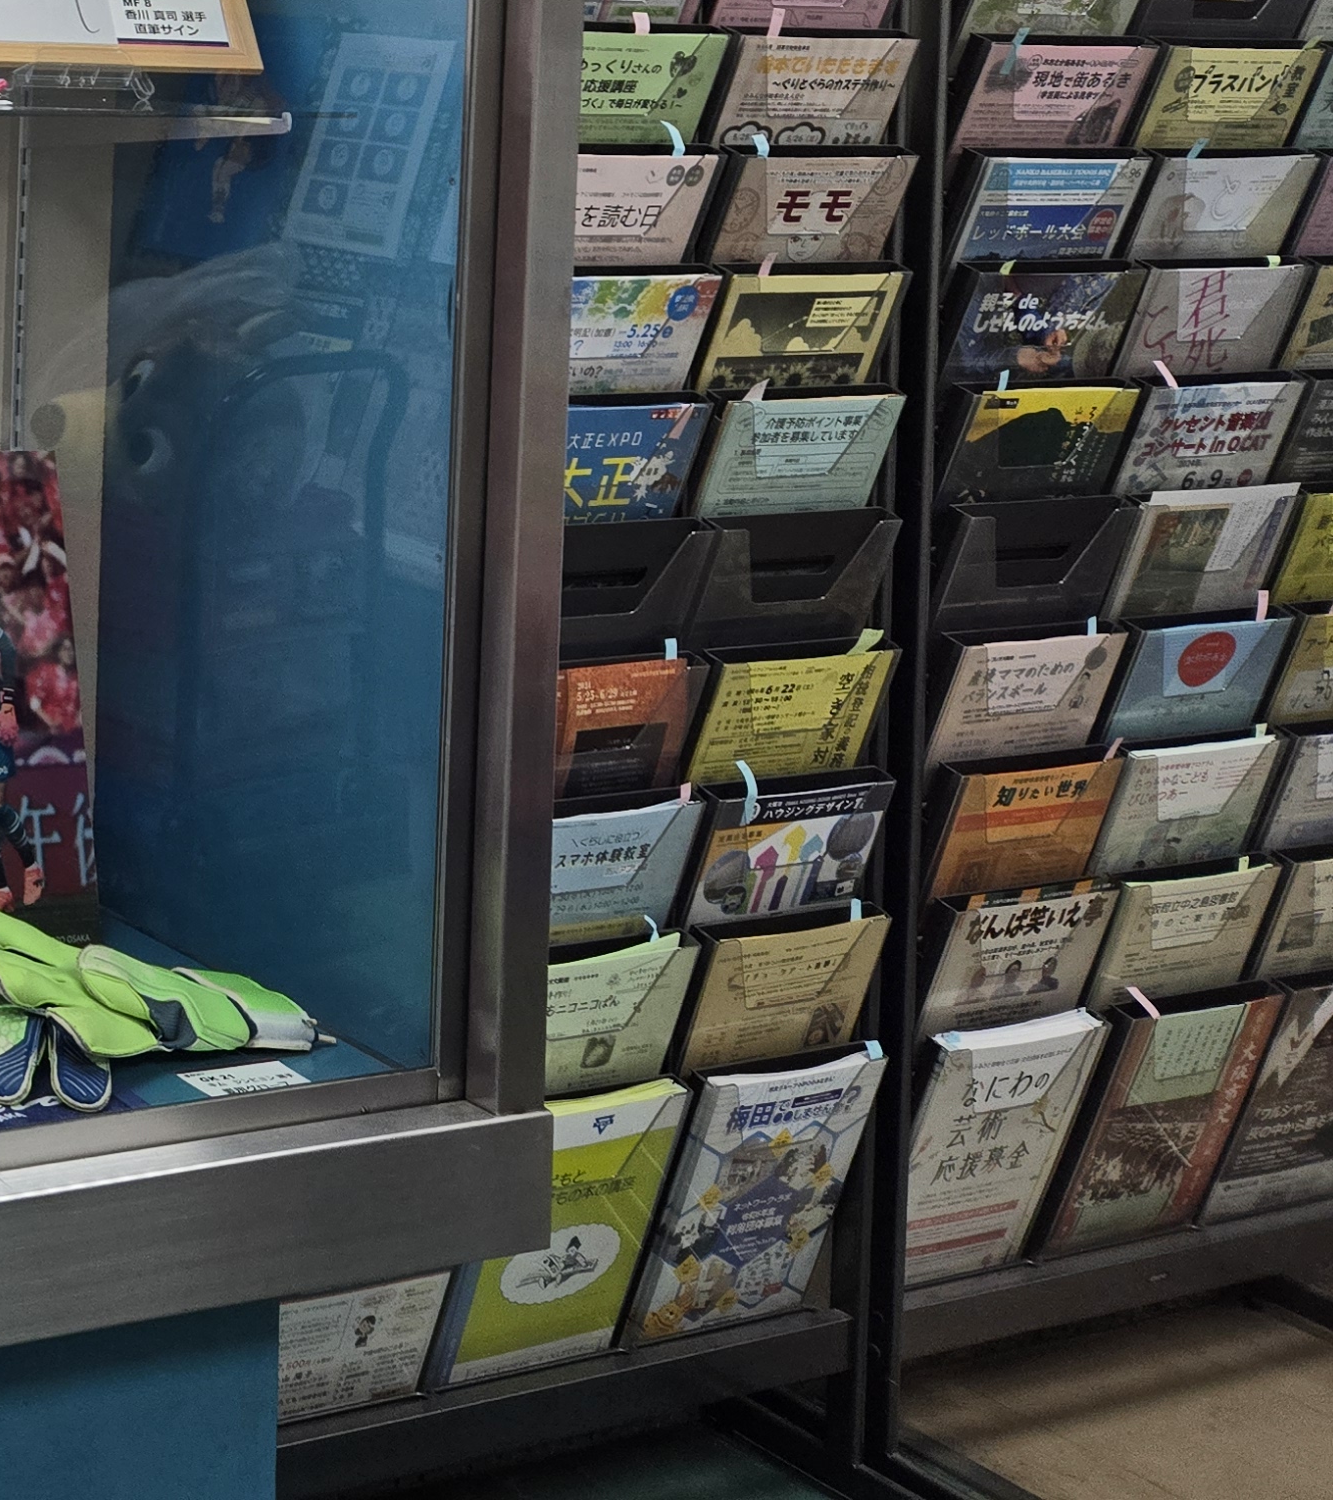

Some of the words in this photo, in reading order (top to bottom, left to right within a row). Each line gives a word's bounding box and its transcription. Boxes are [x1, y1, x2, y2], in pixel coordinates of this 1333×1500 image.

[124, 9, 150, 21] 香川
[153, 10, 178, 21] 真司
[181, 10, 207, 22] 選手
[133, 23, 200, 36] 直筆サイン
[575, 204, 663, 228] を読む日
[776, 190, 852, 223] モモ
[1018, 294, 1040, 310] de
[567, 431, 643, 450] 大正EXPO
[946, 1111, 1007, 1150] 芸術
